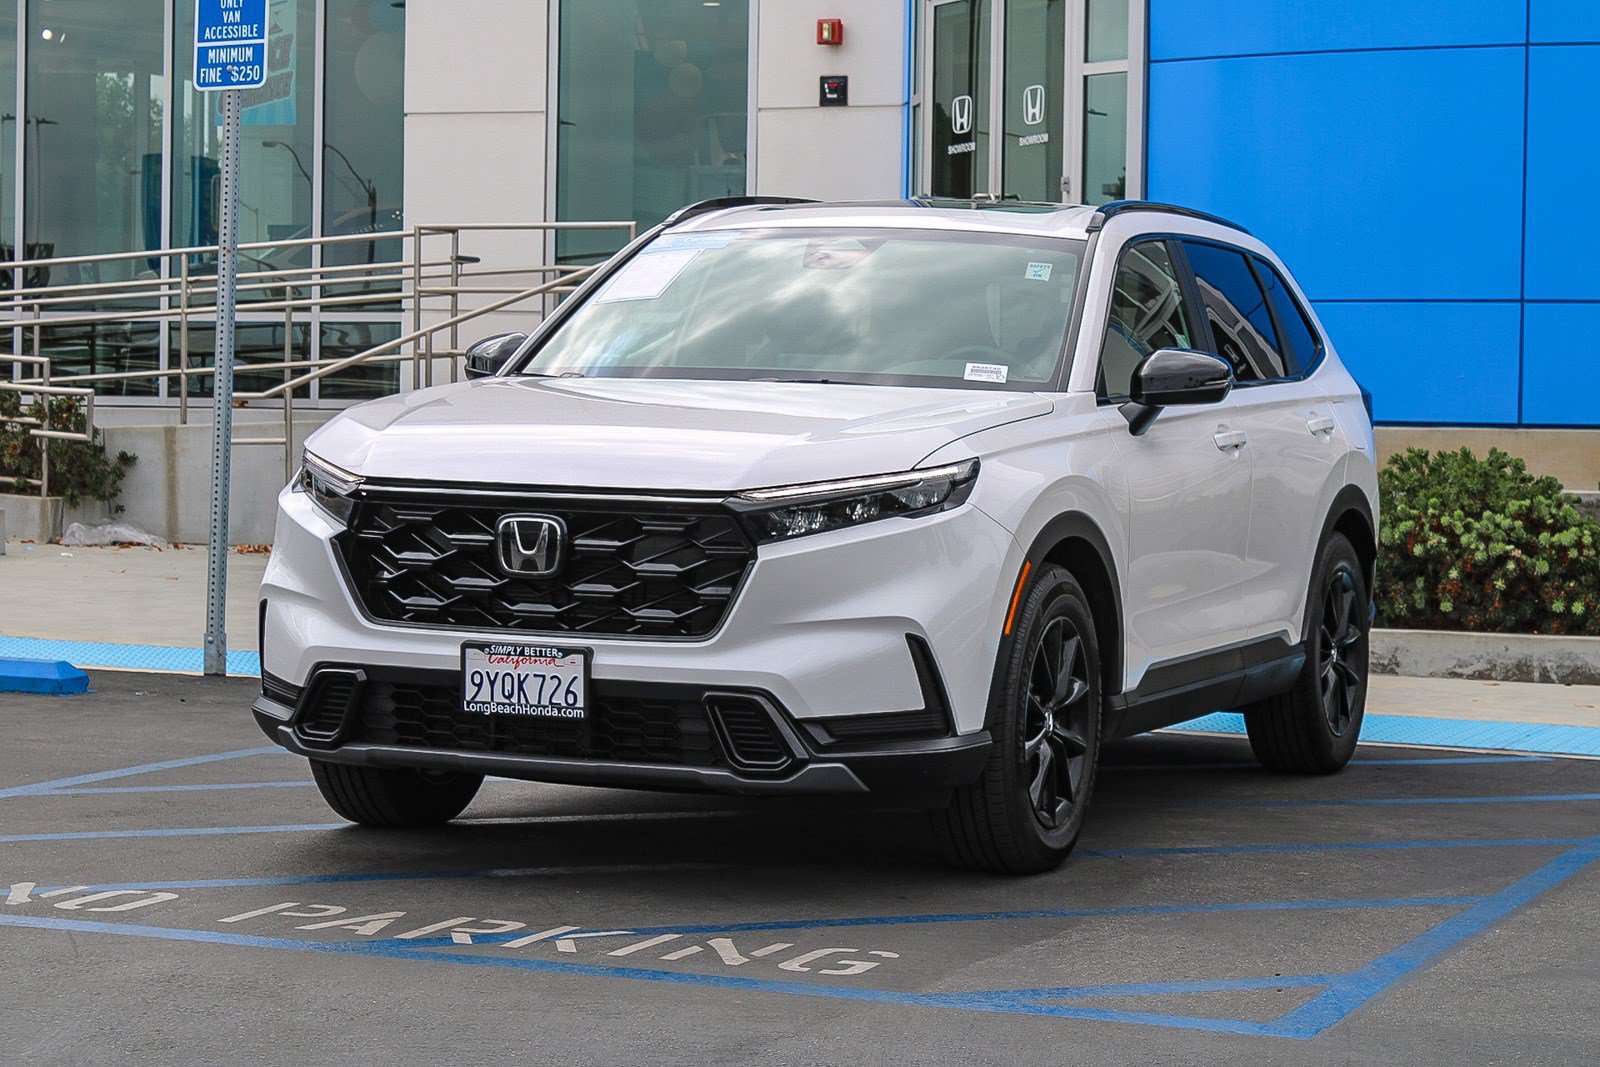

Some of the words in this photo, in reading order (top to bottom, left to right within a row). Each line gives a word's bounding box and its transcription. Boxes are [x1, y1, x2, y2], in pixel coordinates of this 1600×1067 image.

[221, 0, 244, 9] ONLY
[222, 10, 241, 23] VAN
[204, 24, 259, 40] ACCESSIBLE
[208, 47, 253, 64] MINIMUM
[200, 67, 223, 84] FINE
[230, 65, 260, 83] $250
[1018, 133, 1049, 147] SHOWROOM
[947, 141, 976, 155] SHOWROOM
[490, 644, 523, 656] SIMPLY
[524, 647, 558, 657] BETTER
[489, 655, 564, 670] California
[470, 670, 579, 707] 9YQK726
[463, 700, 584, 718] LongBeachHonda.com
[217, 902, 899, 976] PARKING
